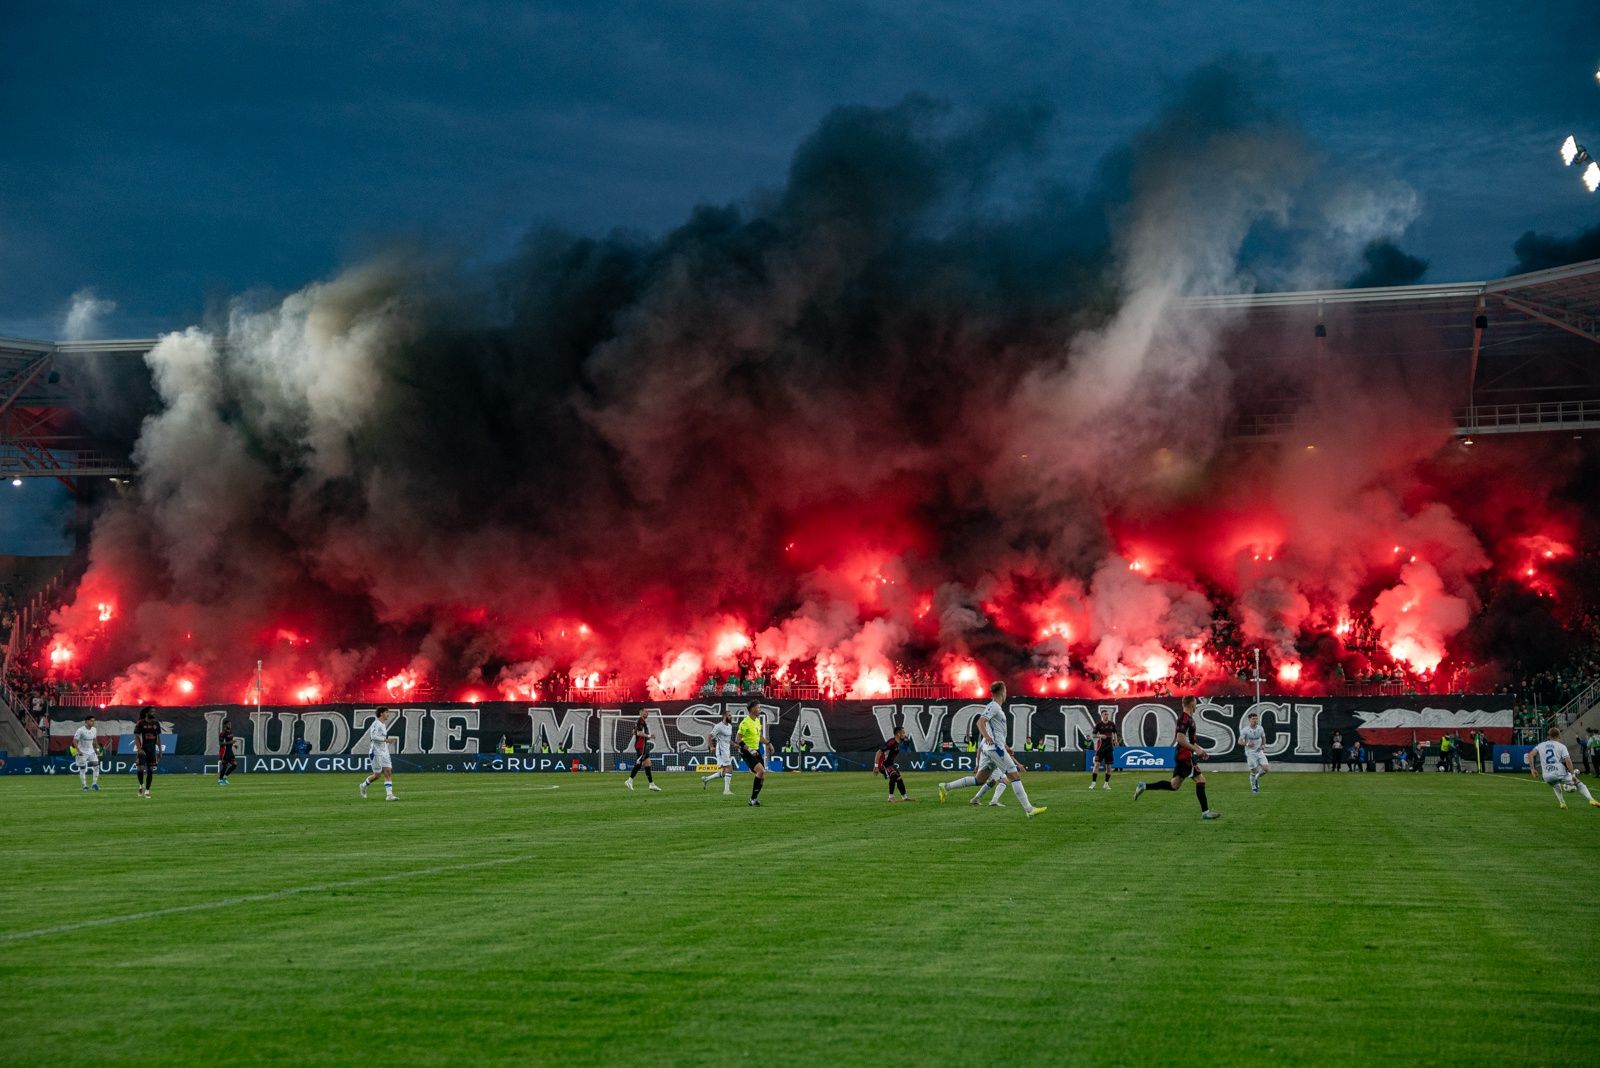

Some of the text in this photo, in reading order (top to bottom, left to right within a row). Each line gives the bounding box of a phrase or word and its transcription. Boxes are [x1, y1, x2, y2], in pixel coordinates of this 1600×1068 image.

[203, 697, 1323, 756] LUDZIE MIASTA WOLNOŚCI
[1126, 755, 1164, 766] Enea
[1545, 749, 1556, 764] 2
[253, 757, 373, 771] ADW GRUP
